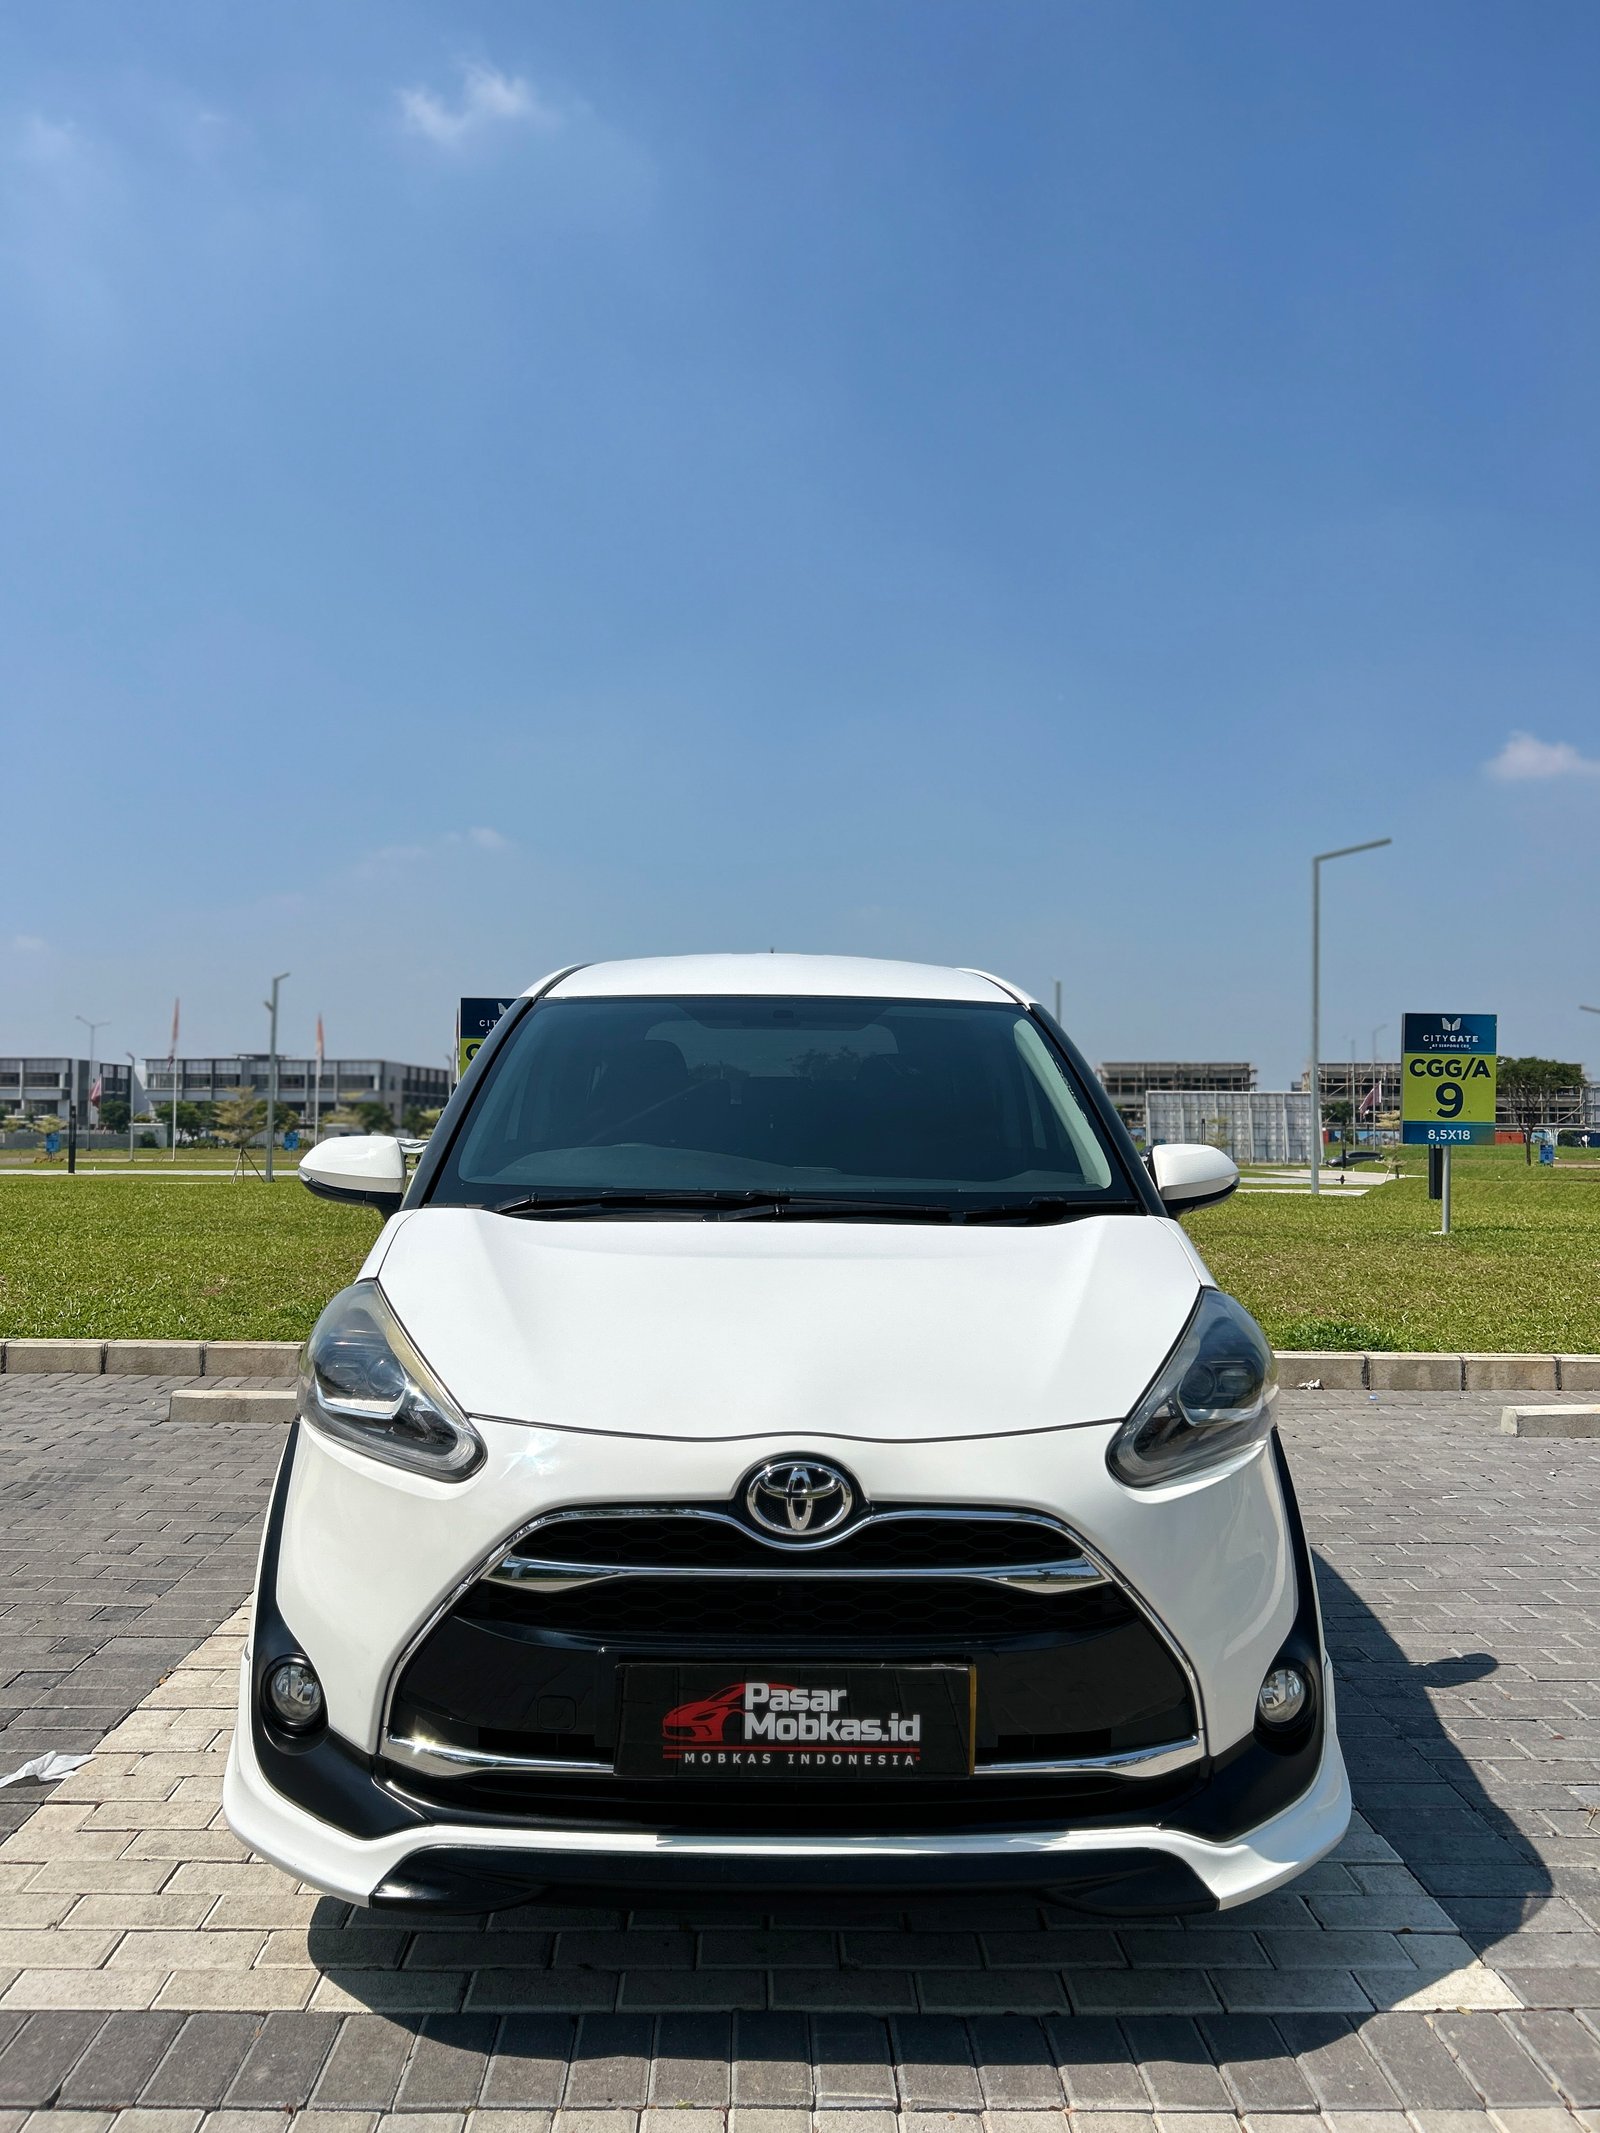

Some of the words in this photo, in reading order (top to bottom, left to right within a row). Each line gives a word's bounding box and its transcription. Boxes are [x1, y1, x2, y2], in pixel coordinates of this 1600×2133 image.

[1423, 1035, 1479, 1043] CITYGATE
[1409, 1058, 1491, 1080] CGG/A
[1435, 1082, 1464, 1118] 9
[1428, 1129, 1471, 1142] 8,5X18
[744, 1682, 847, 1712] Pasar
[744, 1713, 921, 1742] Mobkas.id
[684, 1753, 772, 1765] MOBKAS
[787, 1753, 915, 1766] INDONESIA
